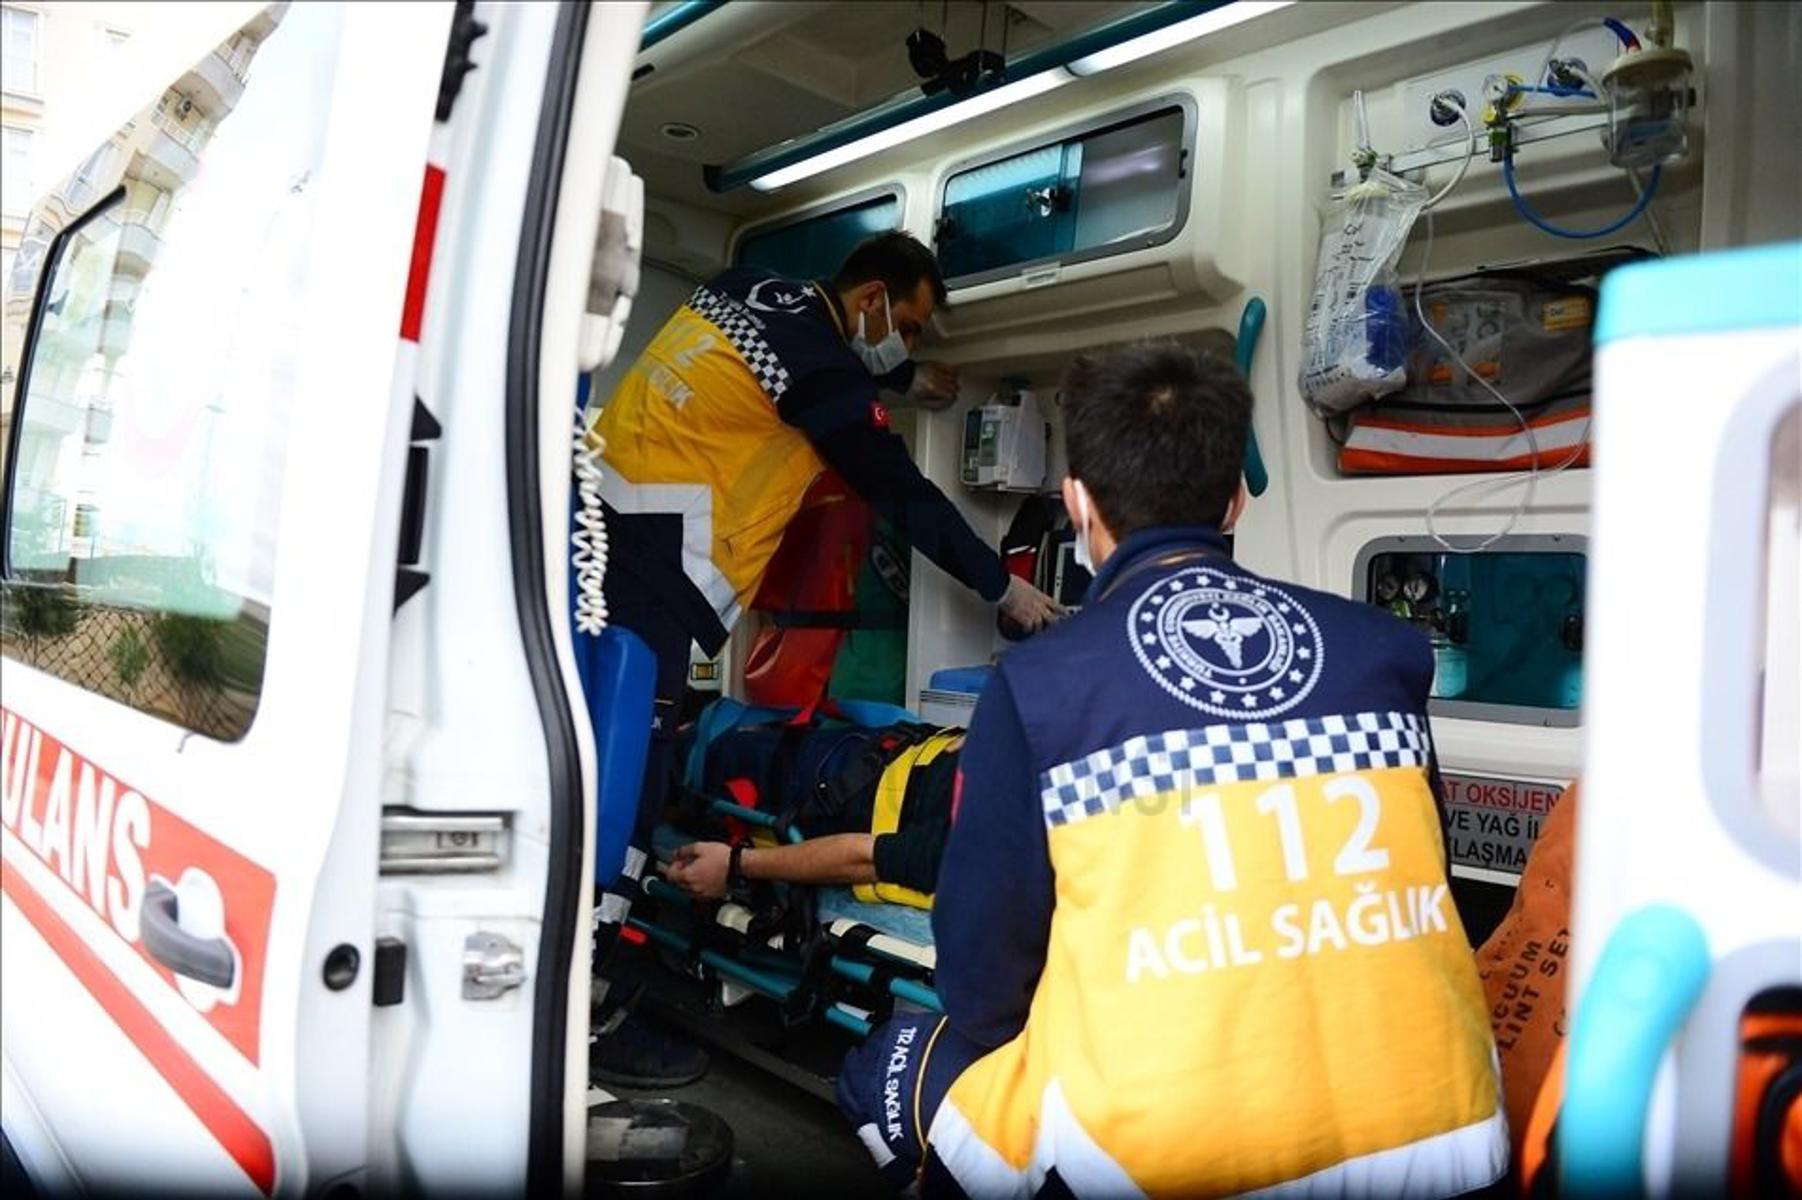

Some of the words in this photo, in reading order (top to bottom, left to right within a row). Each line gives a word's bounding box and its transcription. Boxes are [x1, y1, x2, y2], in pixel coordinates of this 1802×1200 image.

[1466, 783, 1560, 812] OKSİJEN
[0, 708, 151, 942] ULANS
[1177, 775, 1391, 893] 112
[1477, 812, 1521, 838] YAĞ
[1449, 837, 1528, 868] LAŞMA
[1125, 905, 1263, 983] ACİL
[1272, 883, 1450, 960] SAĞLIK
[886, 1045, 910, 1080] ACİL
[883, 1078, 905, 1142] SAĞLIK
